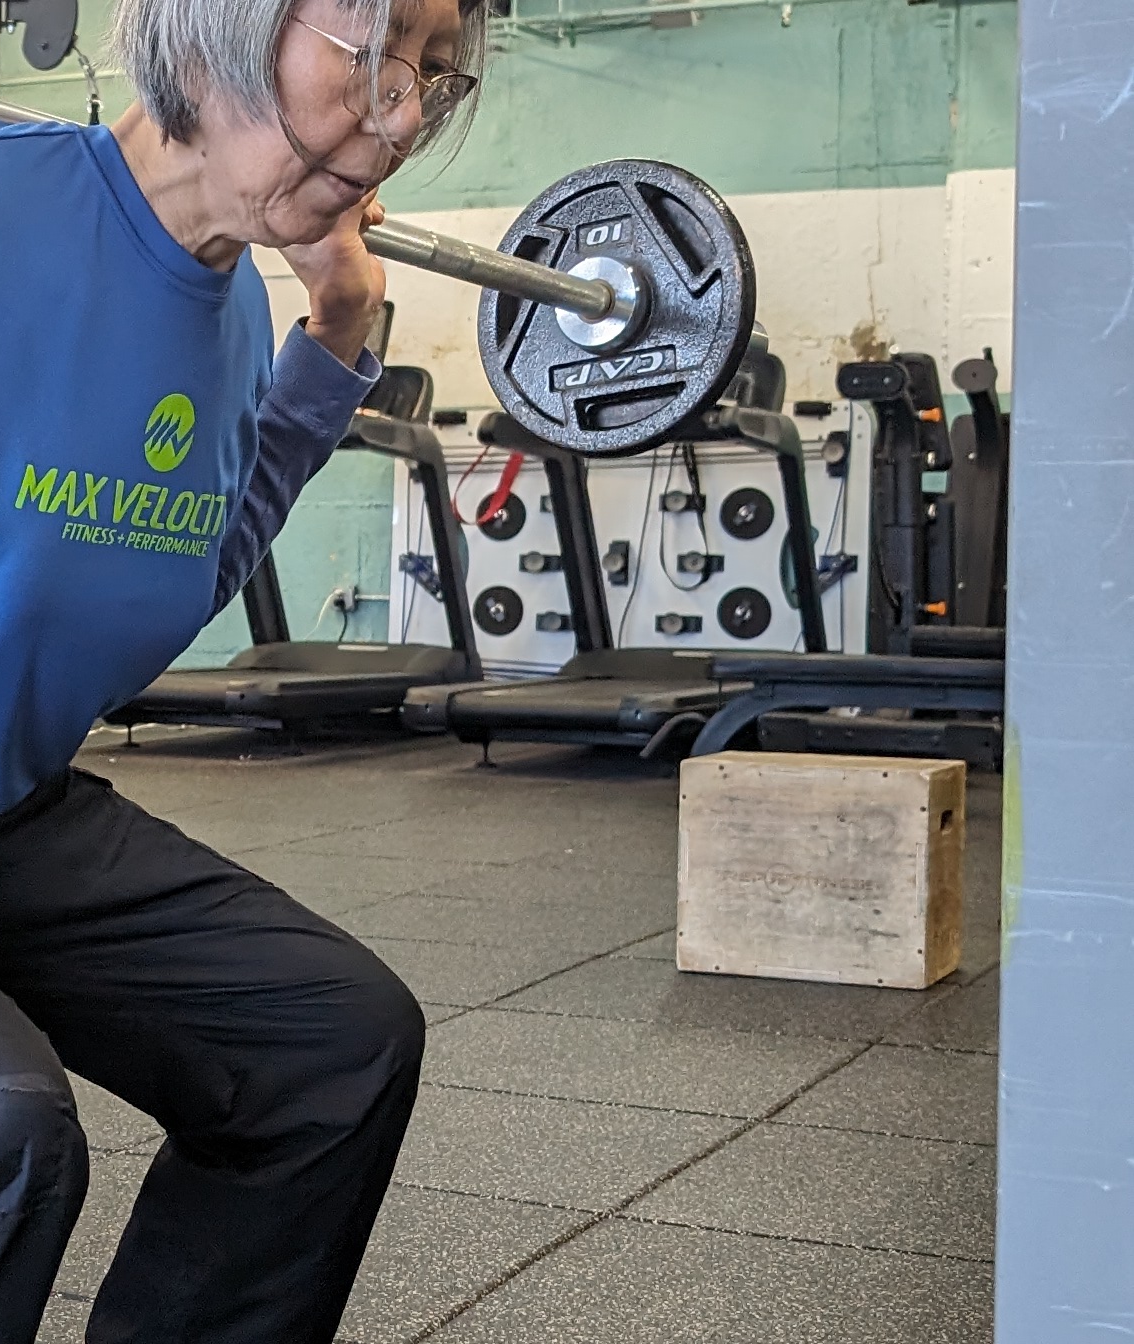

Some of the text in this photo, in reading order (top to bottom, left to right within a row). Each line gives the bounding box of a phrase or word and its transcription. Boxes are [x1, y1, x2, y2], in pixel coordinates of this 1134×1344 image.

[586, 222, 622, 246] 10
[565, 351, 667, 386] CAP
[15, 464, 108, 521] MAX
[62, 522, 117, 545] FITNESS
[125, 532, 209, 558] PERFORMANCE
